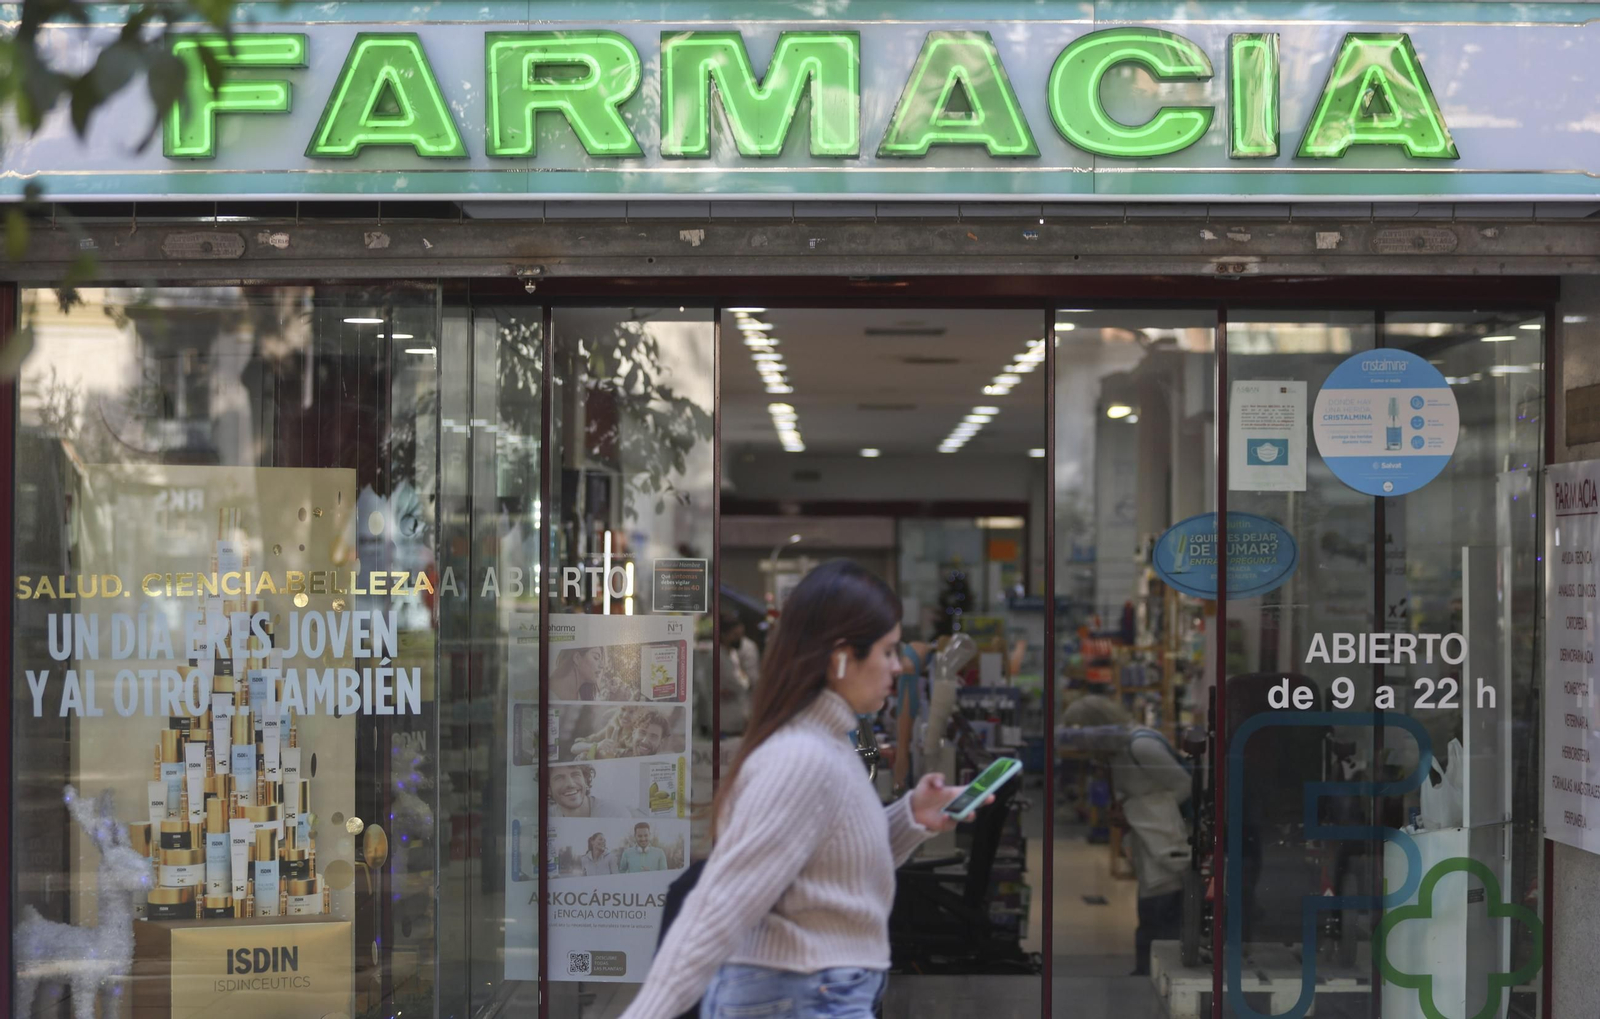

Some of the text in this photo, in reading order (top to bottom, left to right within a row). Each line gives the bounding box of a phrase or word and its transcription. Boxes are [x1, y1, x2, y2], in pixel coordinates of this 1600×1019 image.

[162, 27, 1461, 161] FARMACIA
[1555, 479, 1598, 510] FARMACIA
[1190, 533, 1277, 543] ¿QUIEES DEJAR
[1190, 544, 1210, 556] DE
[1230, 557, 1277, 565] PREGUNTA
[16, 574, 131, 600] SALUD.
[48, 603, 398, 661] UN DÍA ERES JOVEN
[1305, 633, 1468, 665] ABIERTO
[25, 670, 50, 718] Y
[59, 670, 103, 718] AL
[262, 657, 421, 716] TAMBIÉN
[1268, 677, 1497, 709] de 9 a 22 h
[554, 909, 647, 920] ¡ENCAJA CONTIGO!
[226, 946, 299, 975] ISDIN
[214, 976, 311, 992] ISDINCEUTICS
